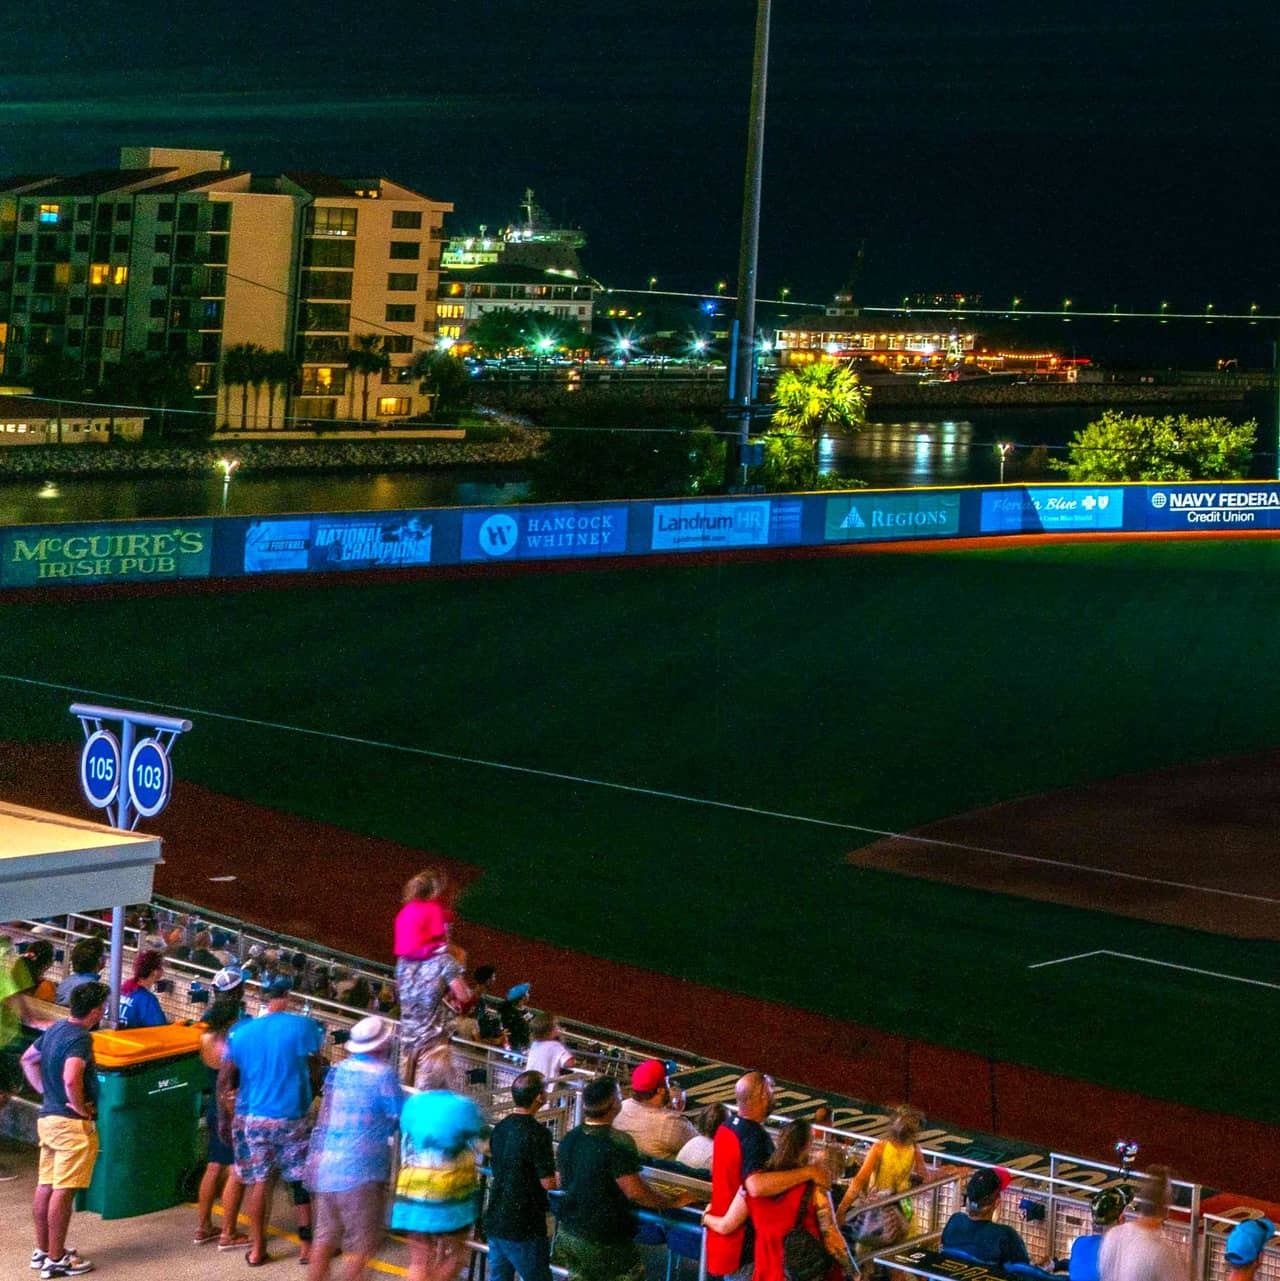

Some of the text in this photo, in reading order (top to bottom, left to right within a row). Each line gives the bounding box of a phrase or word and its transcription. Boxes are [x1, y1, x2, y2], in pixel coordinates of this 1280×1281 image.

[1044, 496, 1078, 511] Blue
[1169, 492, 1217, 508] NAVY
[527, 515, 614, 532] HANCOCK
[658, 512, 733, 532] Landrum
[1187, 511, 1255, 522] Credit Union
[315, 526, 383, 546] NATIONAL
[527, 531, 612, 548] WHITNEY
[342, 540, 425, 561] CHAMPIONS
[38, 557, 177, 578] IRISH PUB
[89, 756, 114, 781] 105
[136, 764, 162, 790] 103
